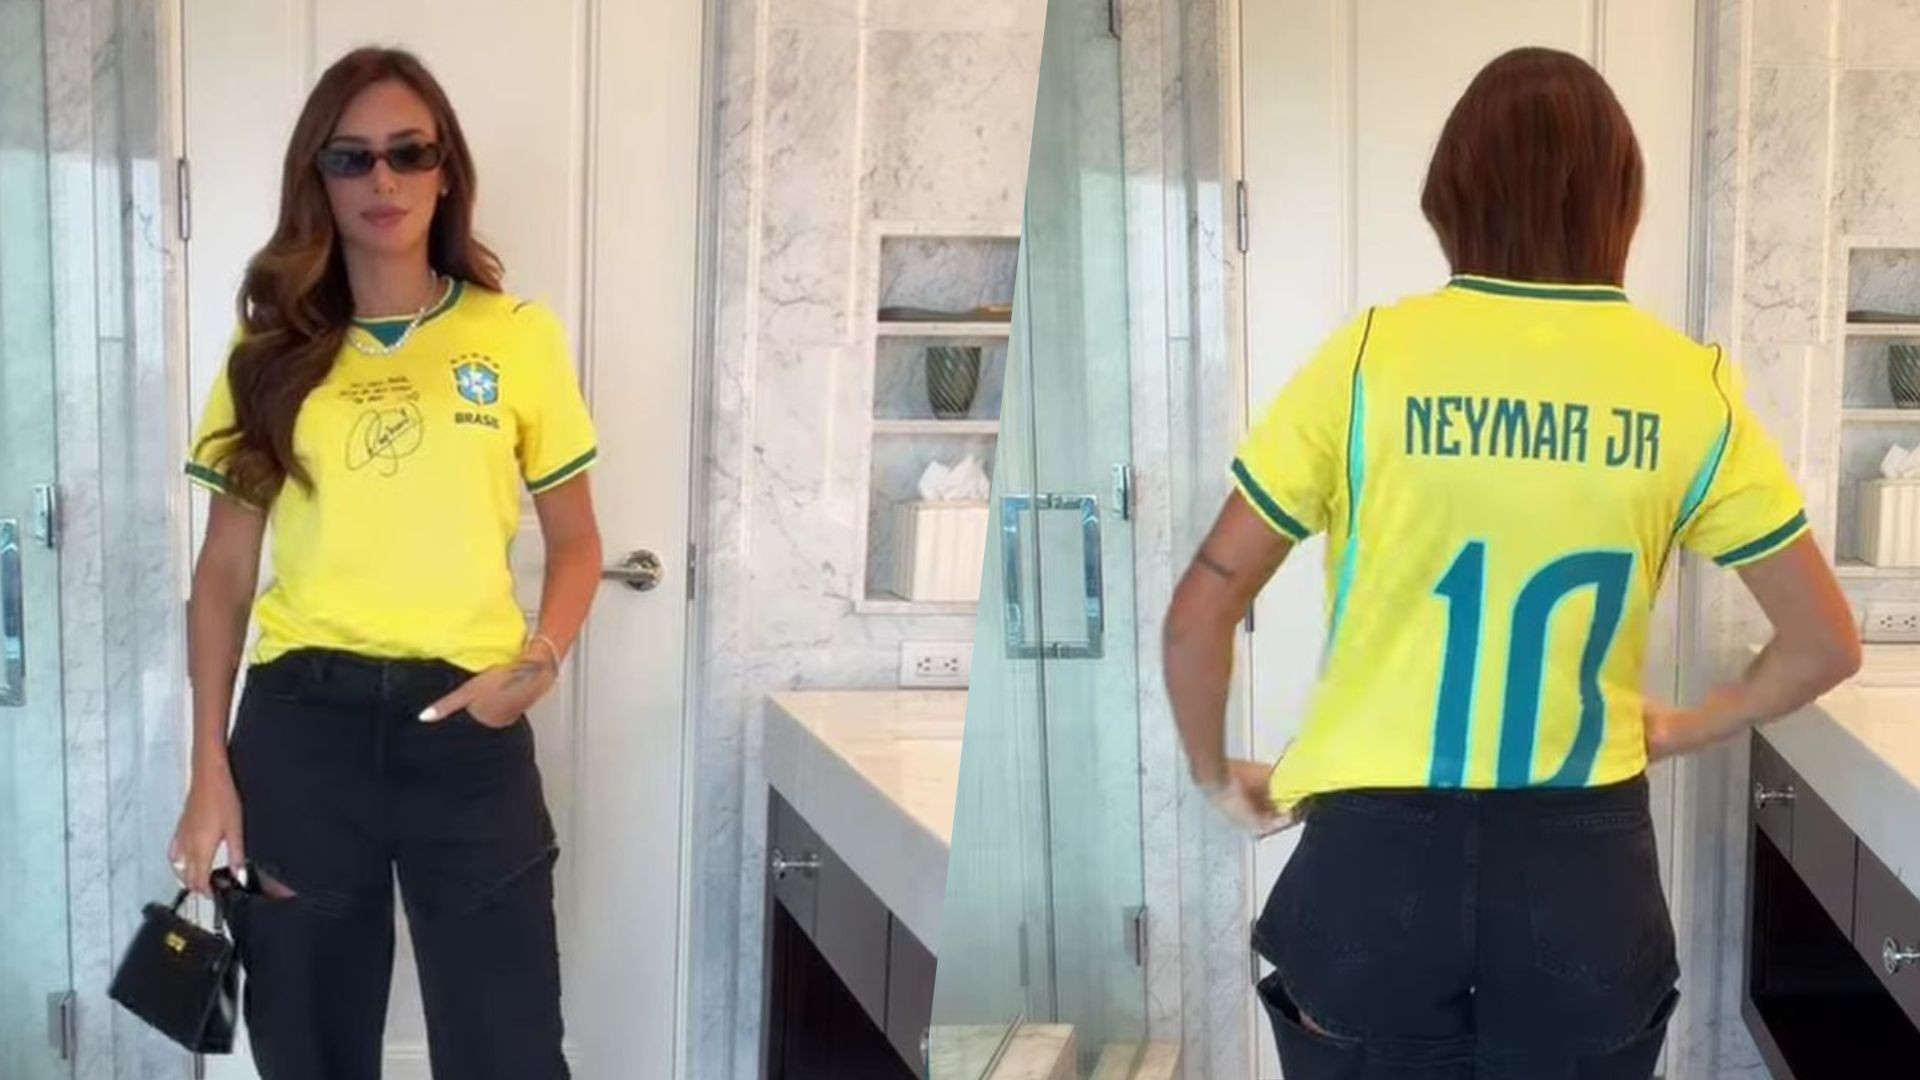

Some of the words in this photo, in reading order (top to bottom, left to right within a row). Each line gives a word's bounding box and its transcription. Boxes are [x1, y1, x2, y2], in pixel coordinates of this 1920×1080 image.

[454, 411, 500, 430] BRASIL
[1405, 396, 1588, 463] NEYMAR
[1605, 407, 1660, 471] JR
[1426, 539, 1636, 789] 10
